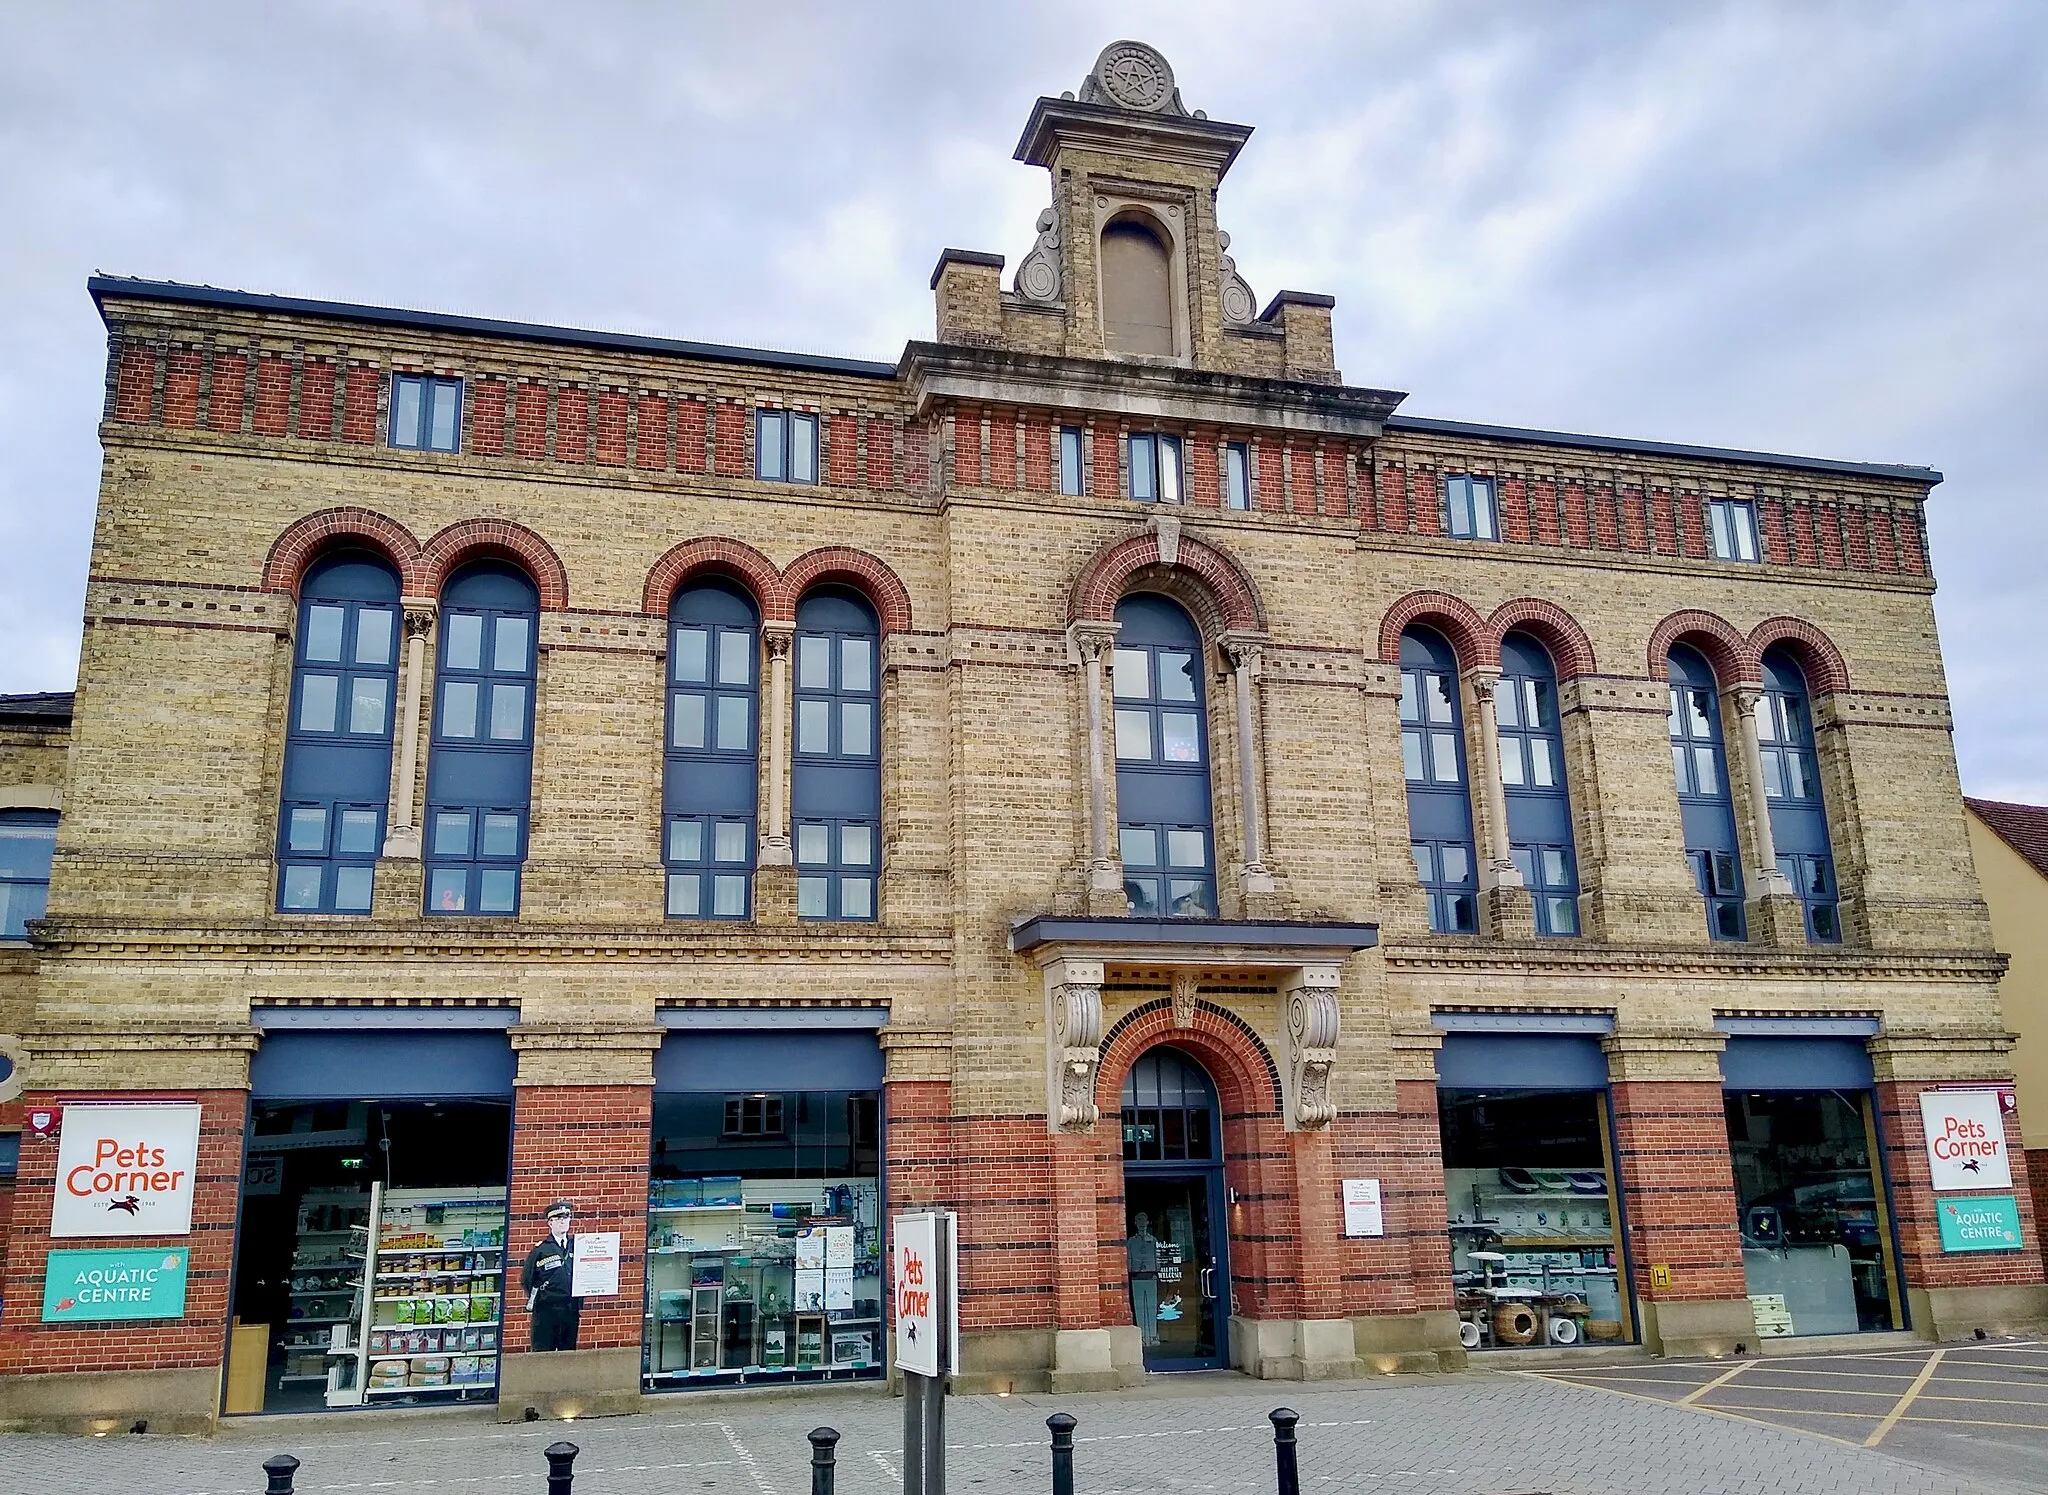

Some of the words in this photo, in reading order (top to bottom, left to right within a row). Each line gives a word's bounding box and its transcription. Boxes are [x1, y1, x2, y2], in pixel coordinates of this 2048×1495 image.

[1944, 1116, 1986, 1139] Pets
[95, 1139, 165, 1168] Pets
[1933, 1137, 1999, 1160] Corner
[66, 1165, 185, 1197] Corner
[1956, 1212, 2003, 1227] AQUATIC
[1960, 1226, 2003, 1239] CENTRE
[1155, 1240, 1180, 1249] Welcome
[904, 1247, 923, 1285] Pets
[74, 1268, 159, 1288] AQUATIC
[1656, 1269, 1668, 1285] H
[78, 1287, 153, 1304] CENTRE
[898, 1281, 930, 1320] Corner
